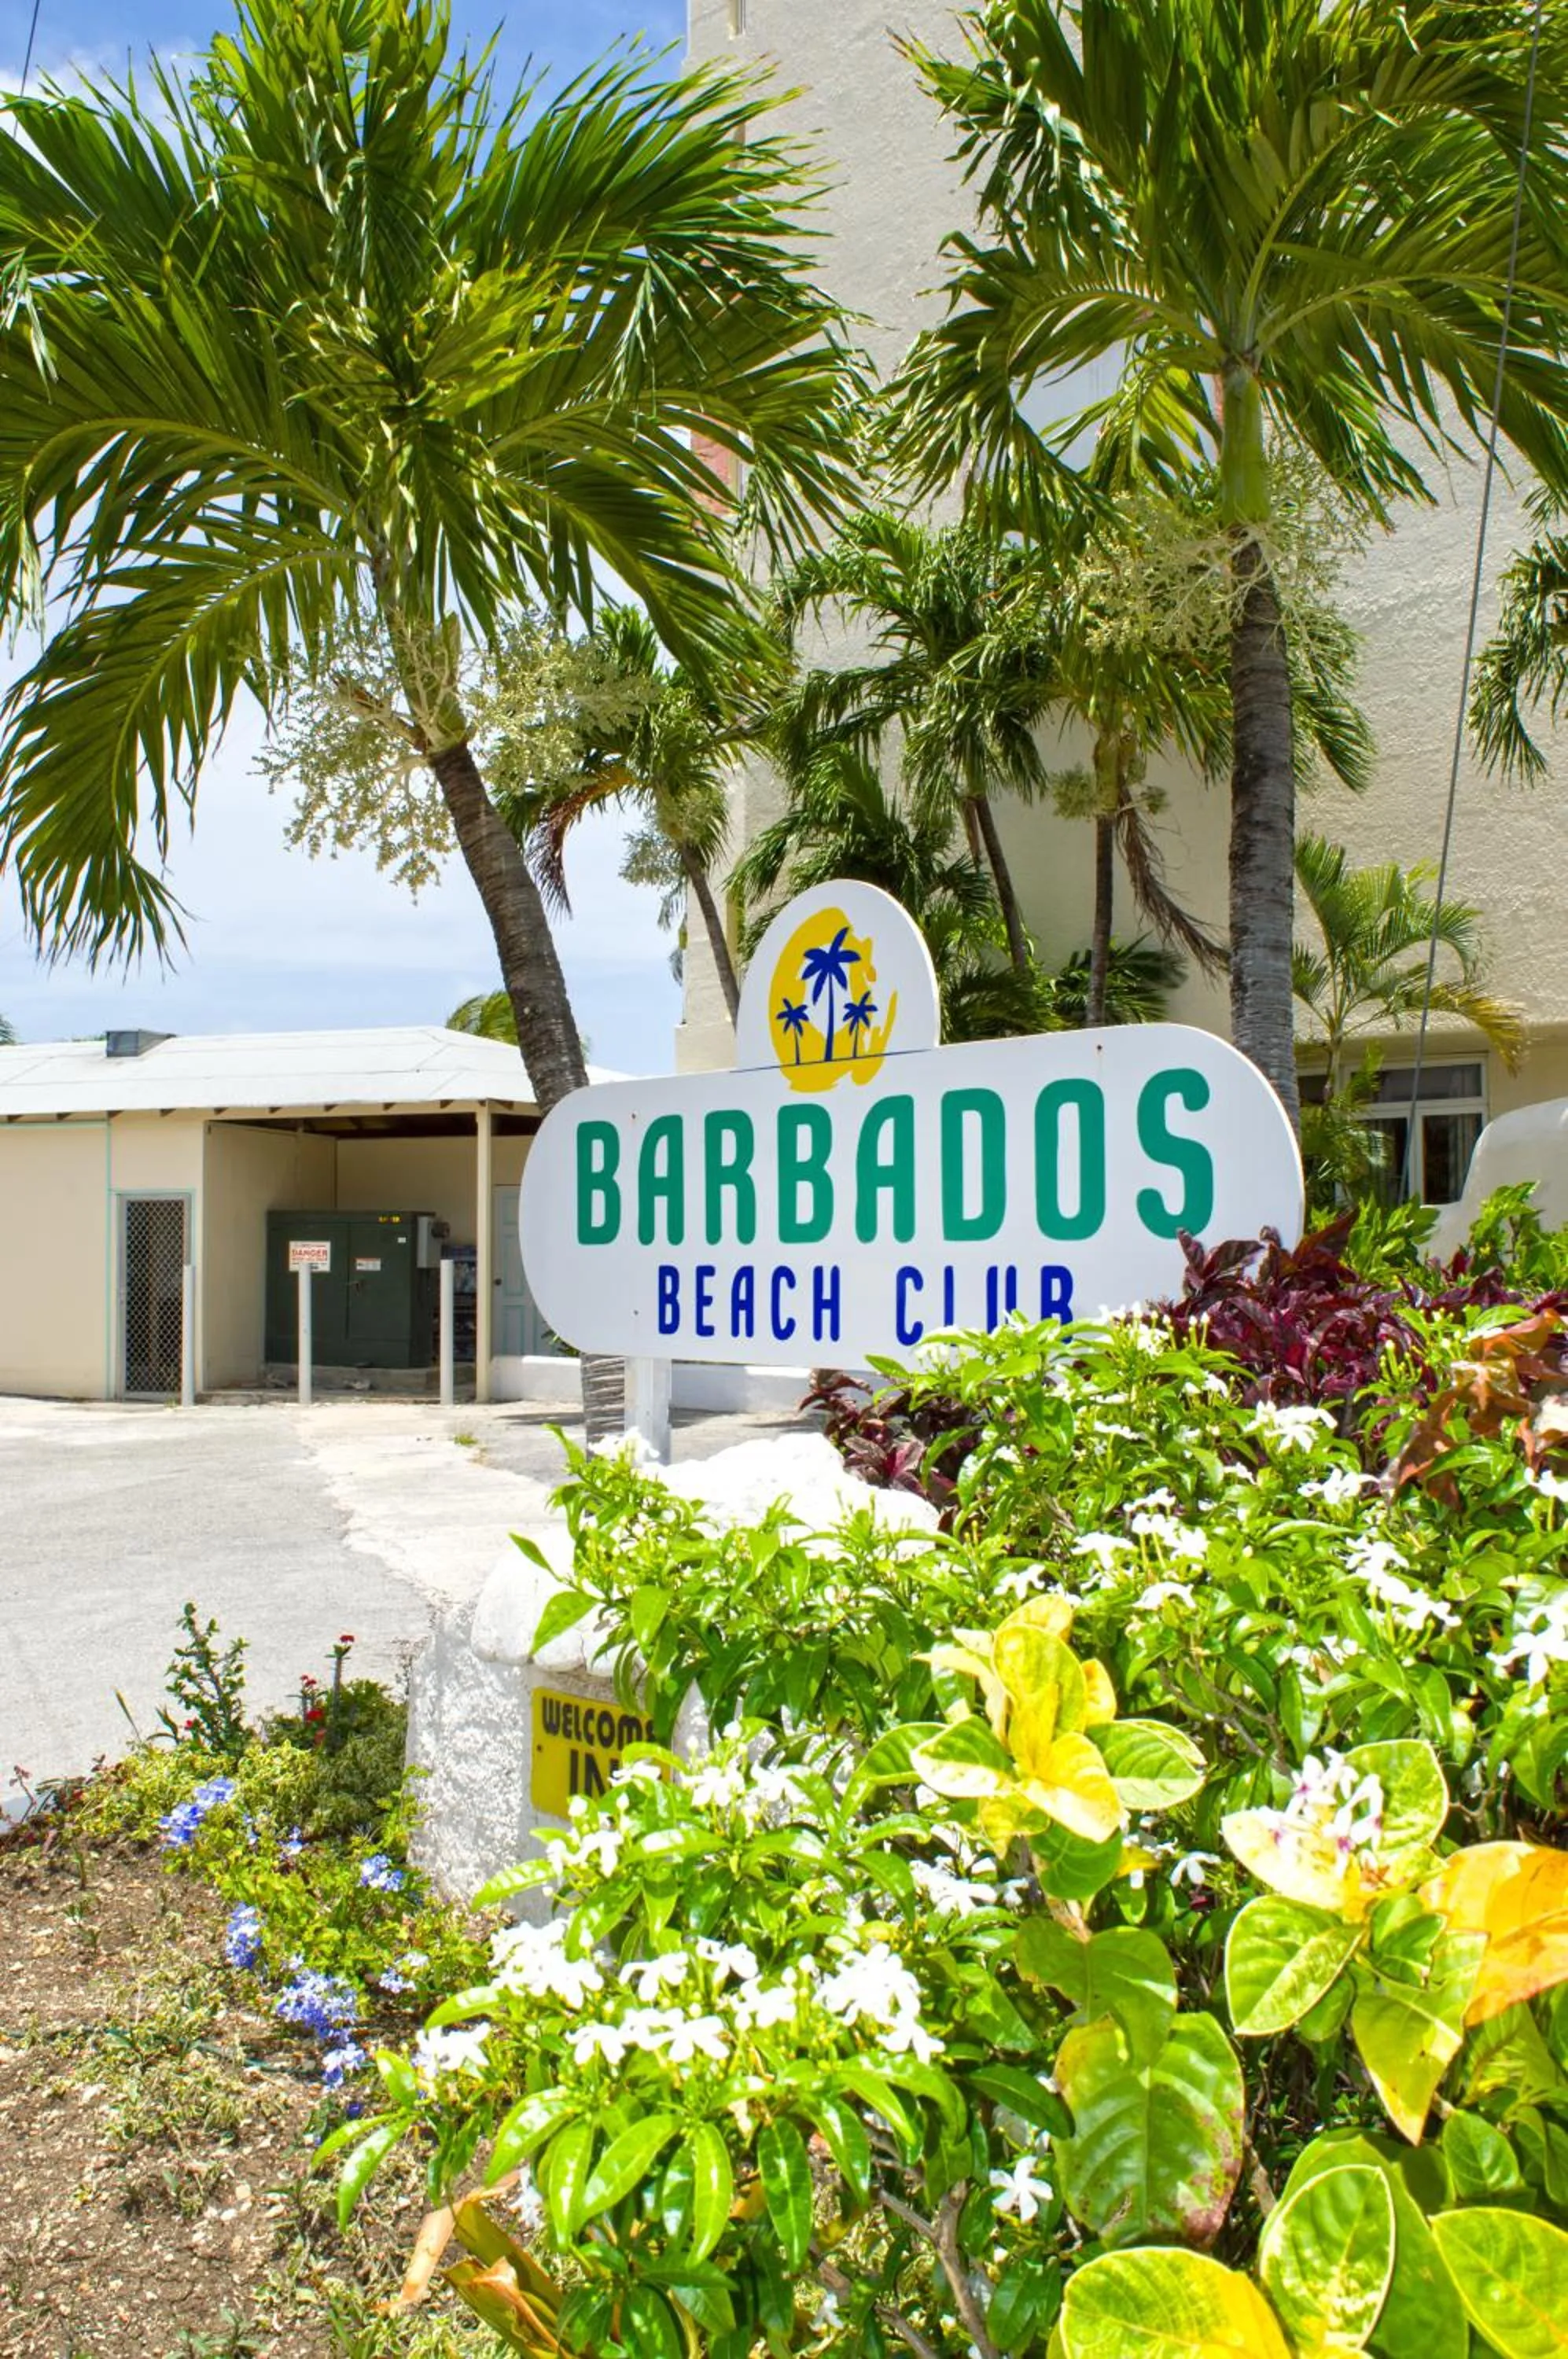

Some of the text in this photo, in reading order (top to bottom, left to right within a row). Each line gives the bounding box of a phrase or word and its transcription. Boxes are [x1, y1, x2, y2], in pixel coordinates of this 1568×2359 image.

[575, 1066, 1216, 1247] BARBADOS
[657, 1264, 1074, 1345] BEACH CLUB
